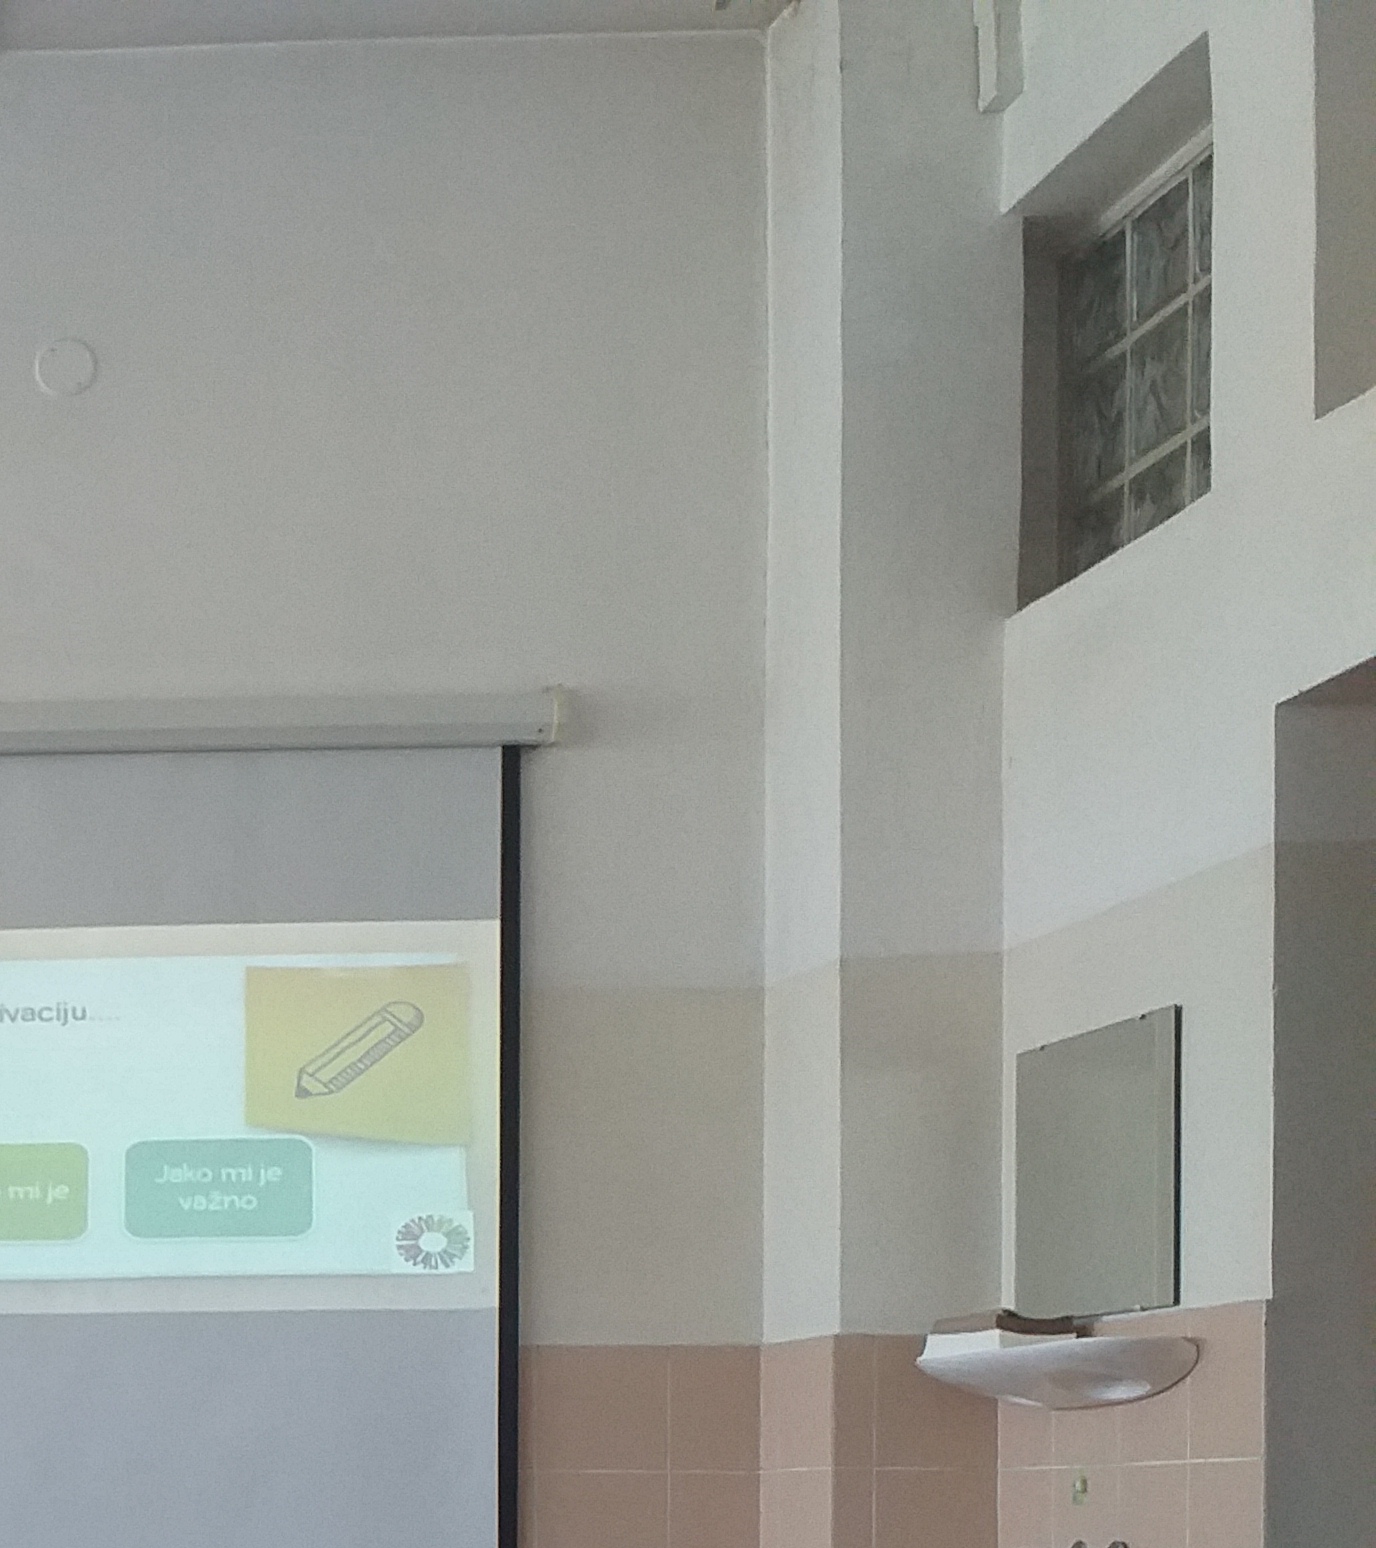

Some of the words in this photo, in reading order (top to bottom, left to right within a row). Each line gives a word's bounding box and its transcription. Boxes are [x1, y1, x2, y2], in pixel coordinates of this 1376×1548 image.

[154, 1163, 213, 1184] Jako
[221, 1163, 252, 1183] mi
[259, 1163, 283, 1186] je
[8, 1181, 40, 1200] mi
[46, 1181, 70, 1206] je
[177, 1191, 258, 1211] važno
